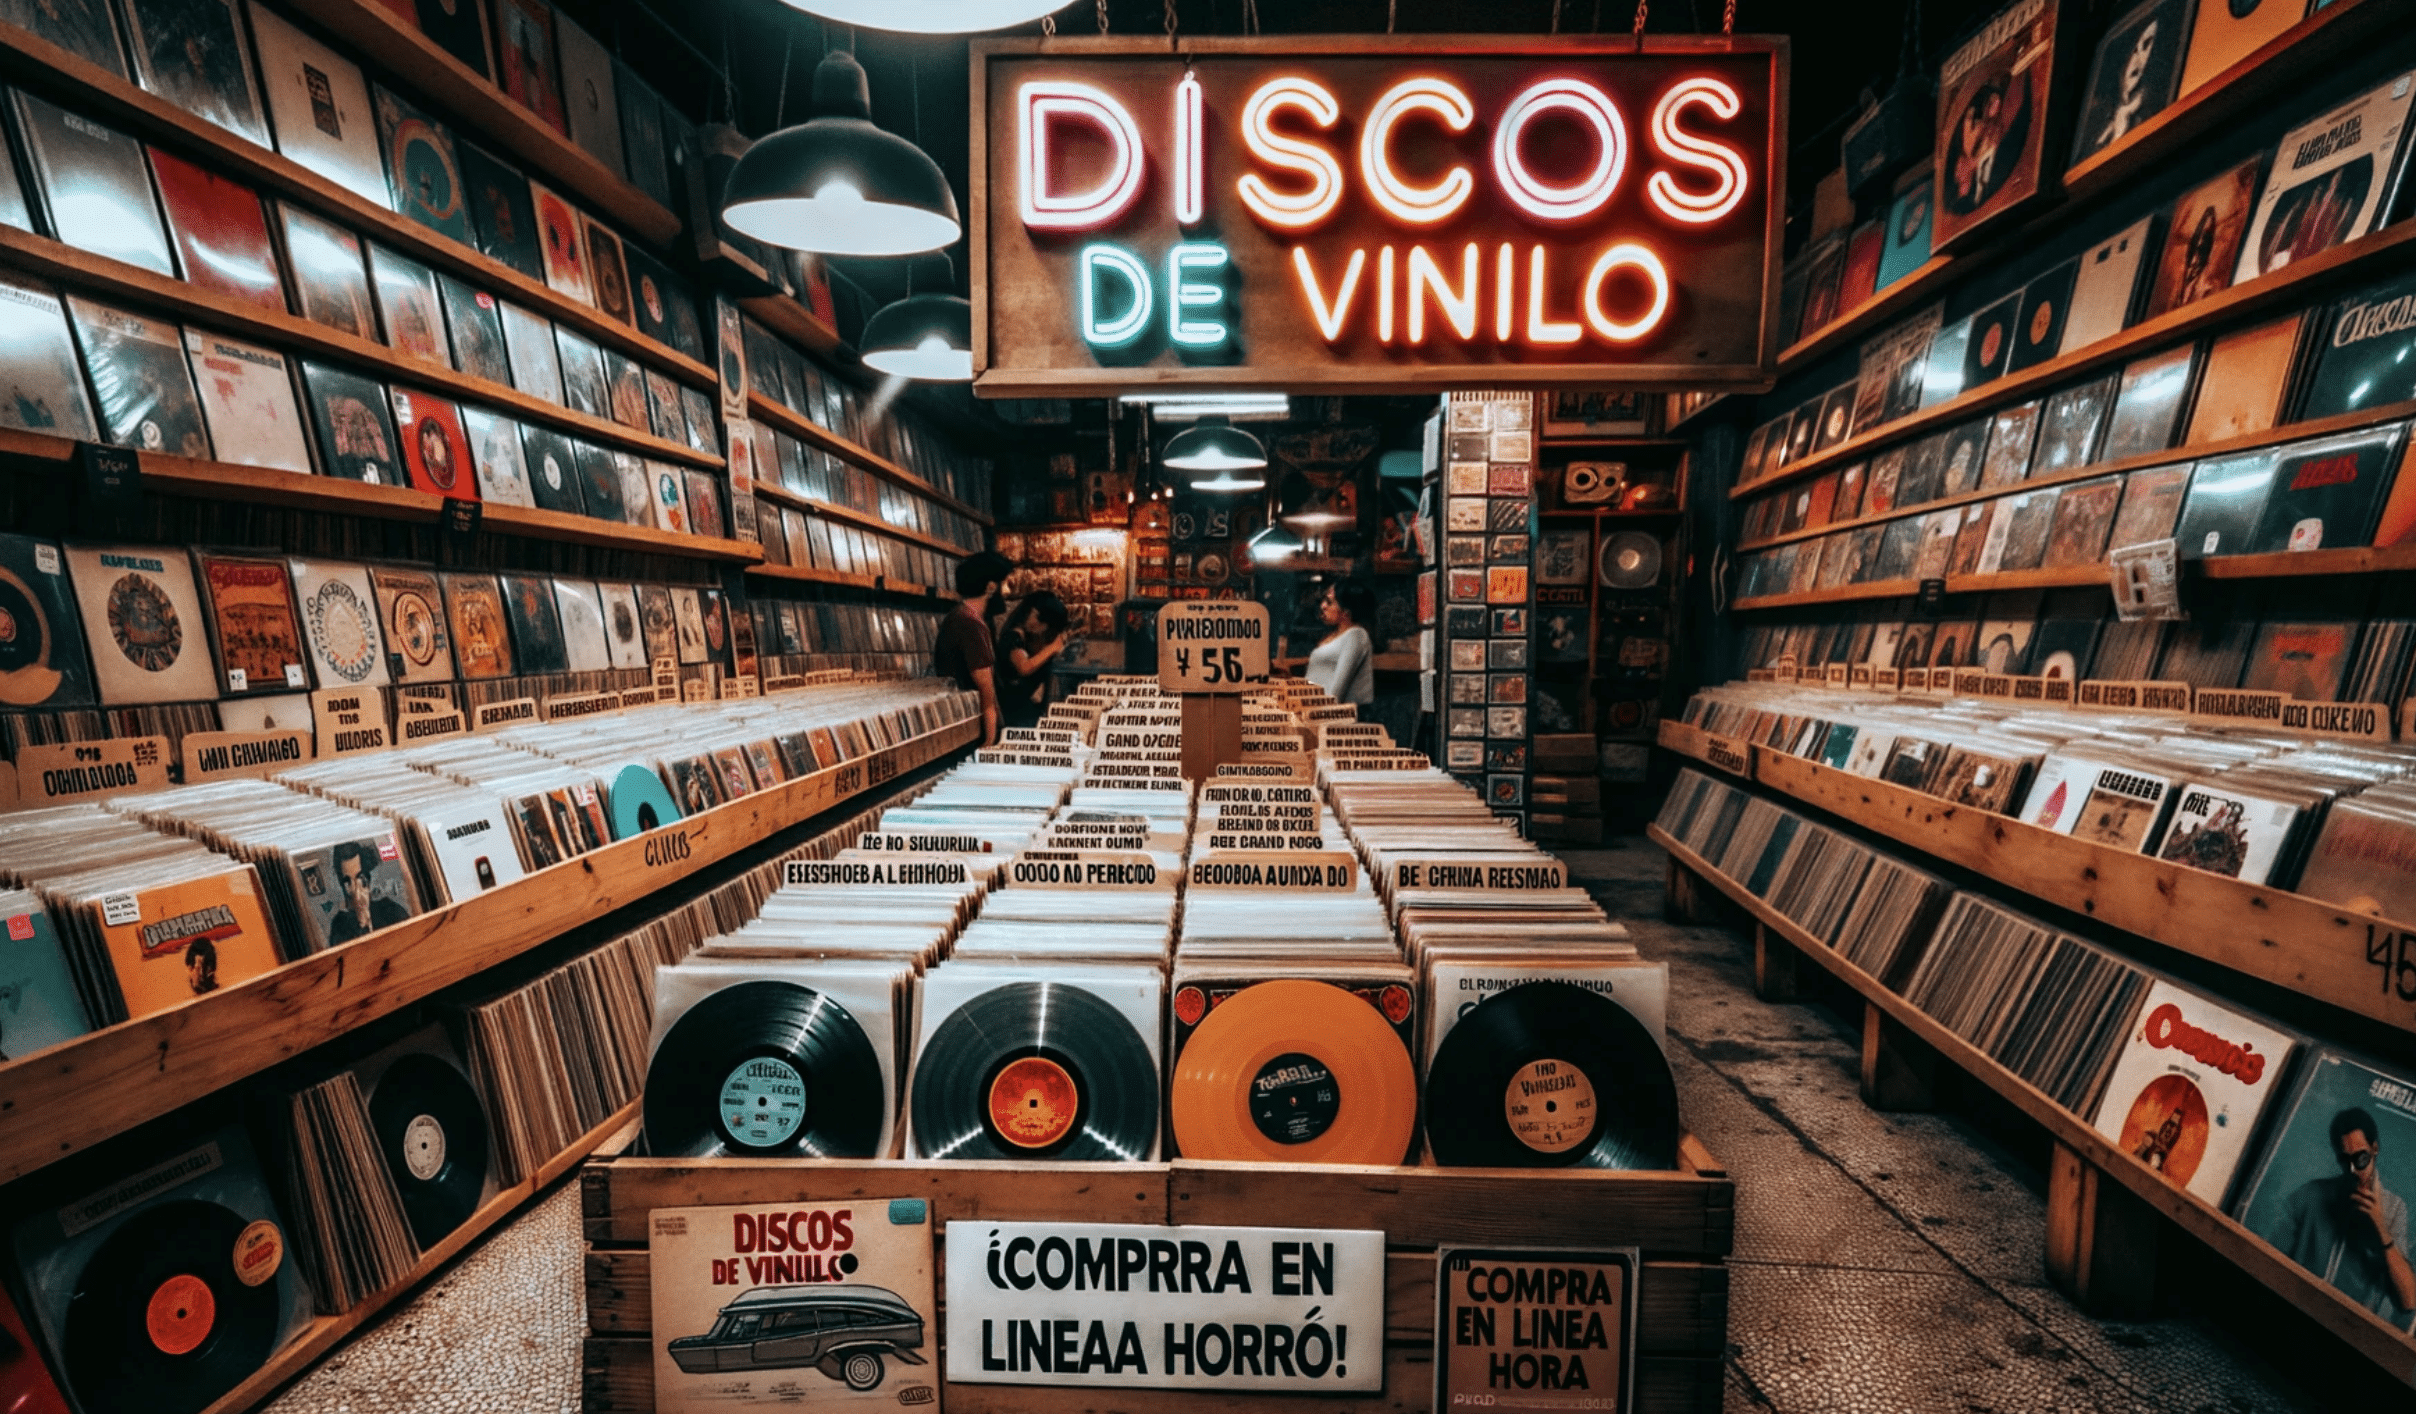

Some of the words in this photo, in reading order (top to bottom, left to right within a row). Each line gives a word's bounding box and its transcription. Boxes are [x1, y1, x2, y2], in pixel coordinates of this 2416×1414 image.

[1017, 76, 1748, 228] DISCOS
[1080, 243, 1229, 347] DE
[1292, 242, 1671, 344] VINILO
[733, 1209, 854, 1254] DISCOS
[711, 1257, 740, 1286] DE
[1271, 1240, 1335, 1297] EN
[981, 1318, 1148, 1377] LINEAA
[1163, 1305, 1348, 1380] HORRÓ!
[1456, 1305, 1496, 1347] EN
[1512, 1307, 1609, 1350] LINEA
[1488, 1352, 1591, 1390] HORA
